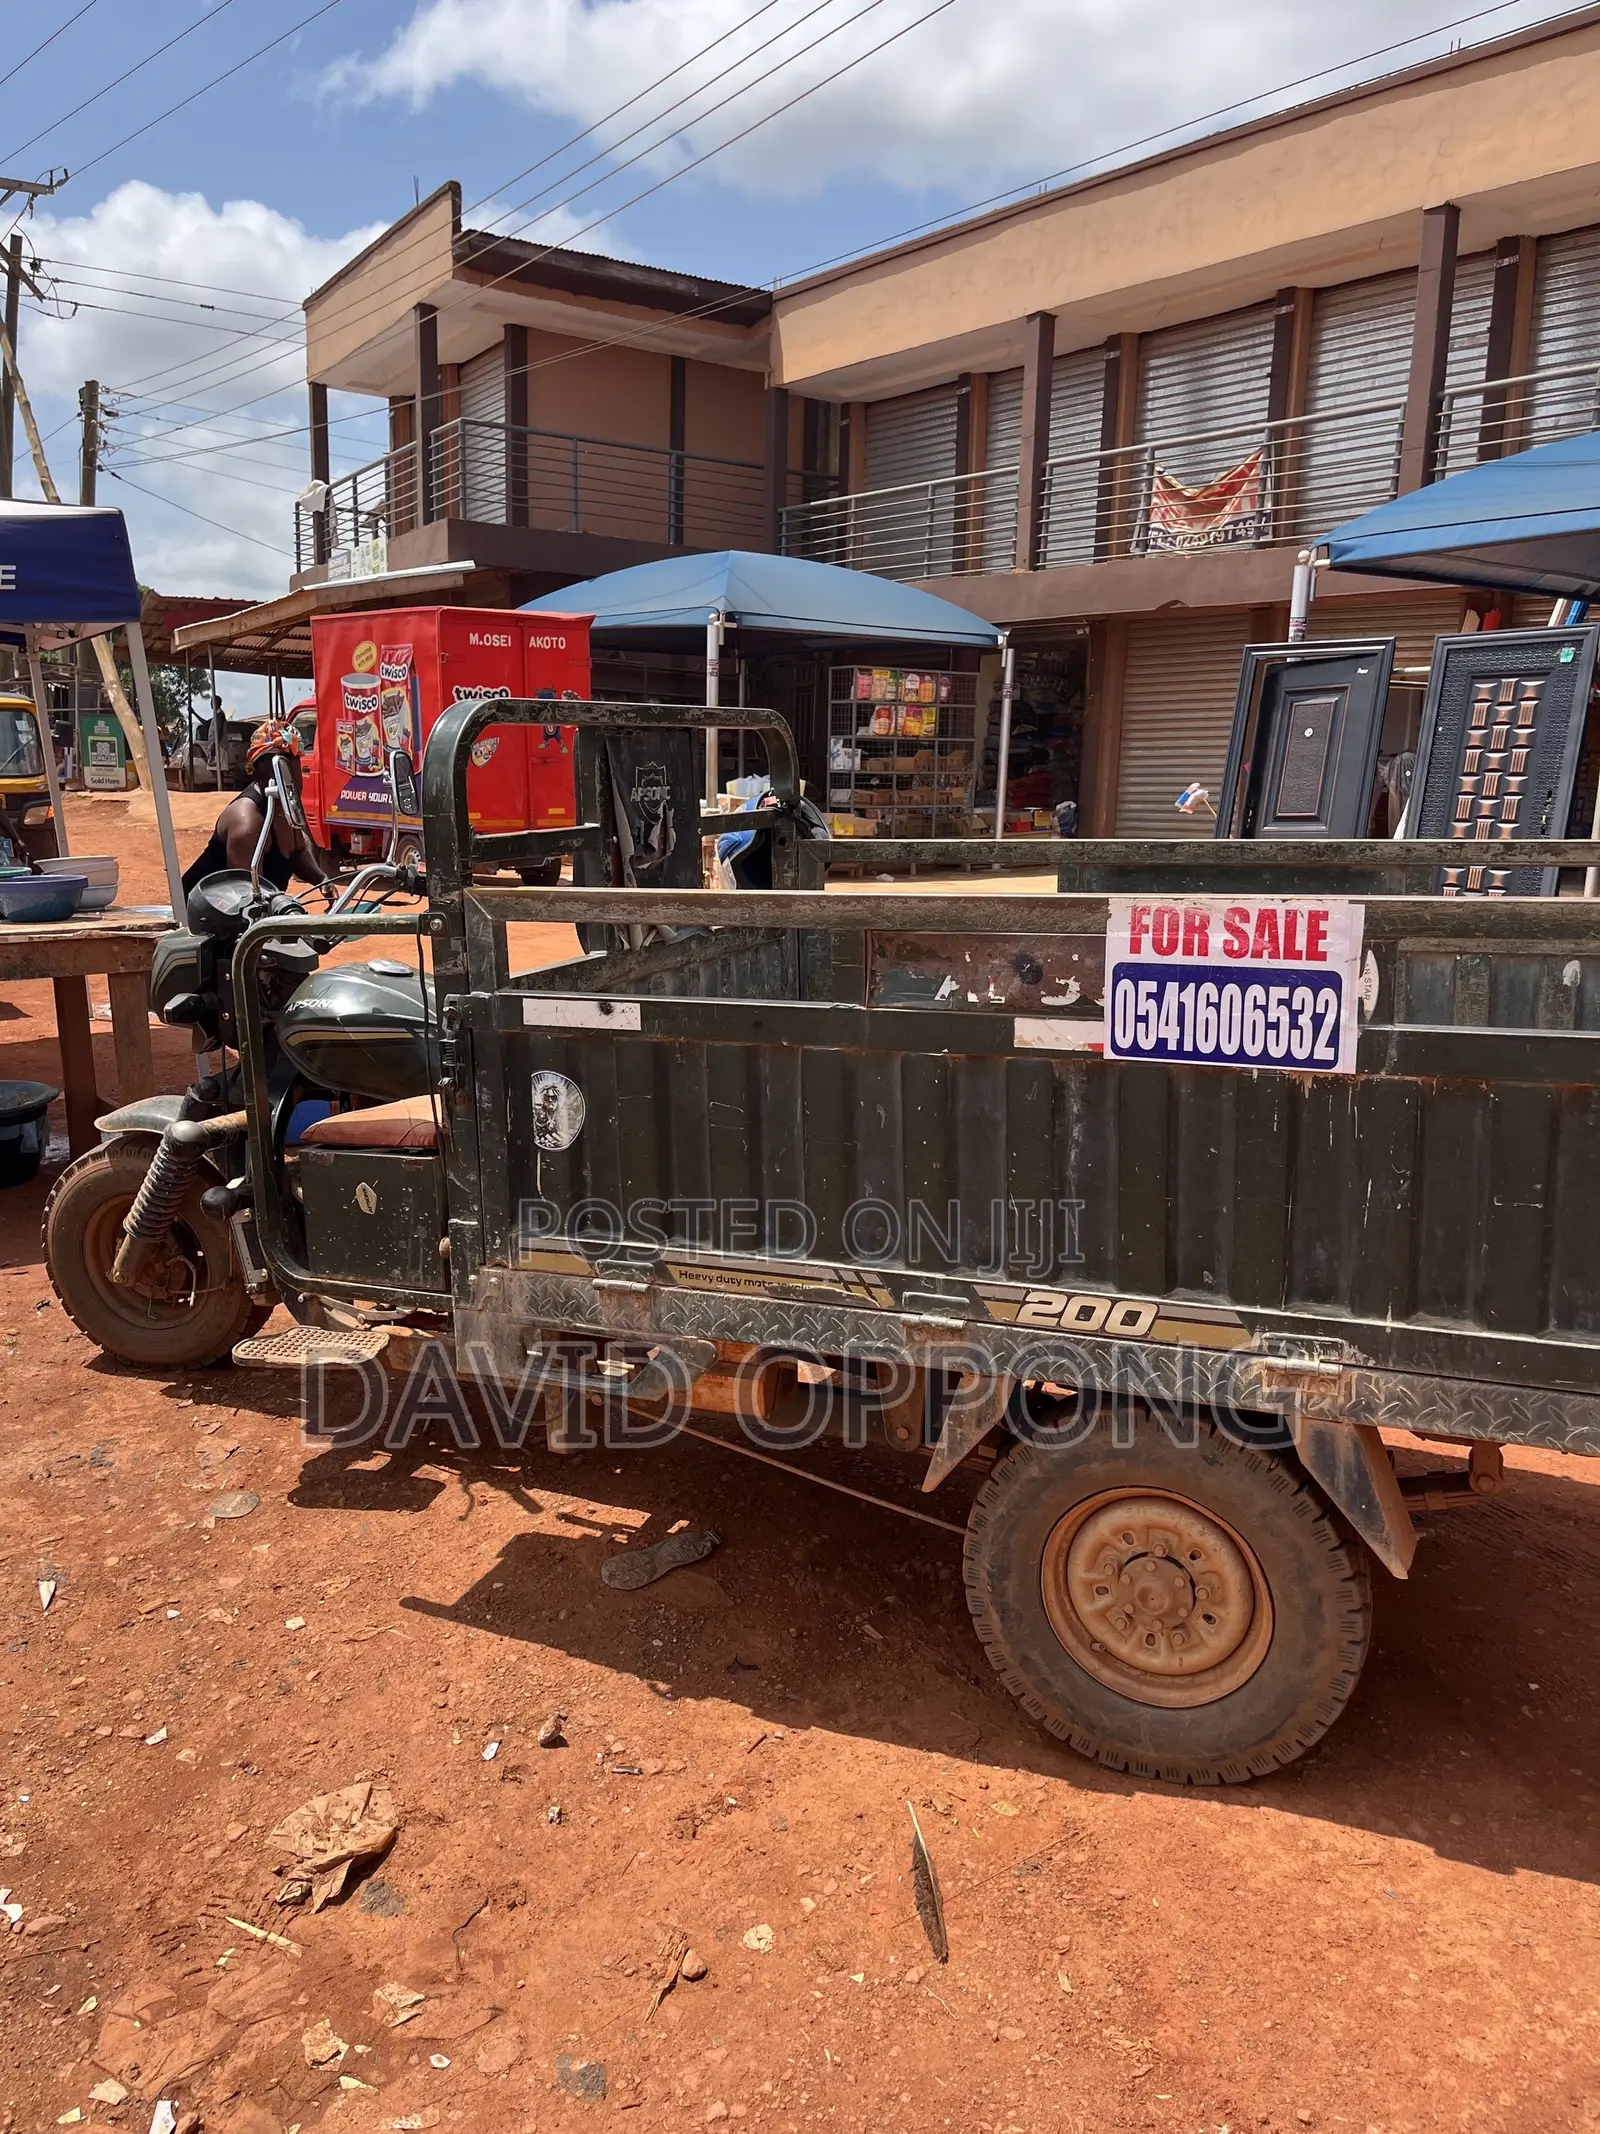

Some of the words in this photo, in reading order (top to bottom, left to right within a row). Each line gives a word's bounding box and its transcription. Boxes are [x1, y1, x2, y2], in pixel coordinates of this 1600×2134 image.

[469, 632, 511, 647] M.OSEI
[529, 636, 567, 650] AKOTO
[380, 663, 407, 679] twisco
[345, 694, 378, 711] twisco
[340, 789, 366, 801] POWER
[368, 792, 388, 804] YOUR
[1129, 905, 1211, 957] FOR
[1222, 907, 1329, 962] SALE
[1363, 977, 1372, 1001] STAR
[1114, 978, 1338, 1061] 0541606532
[678, 1269, 714, 1284] Heavy
[716, 1274, 742, 1287] duty
[1016, 1291, 1159, 1337] 200
